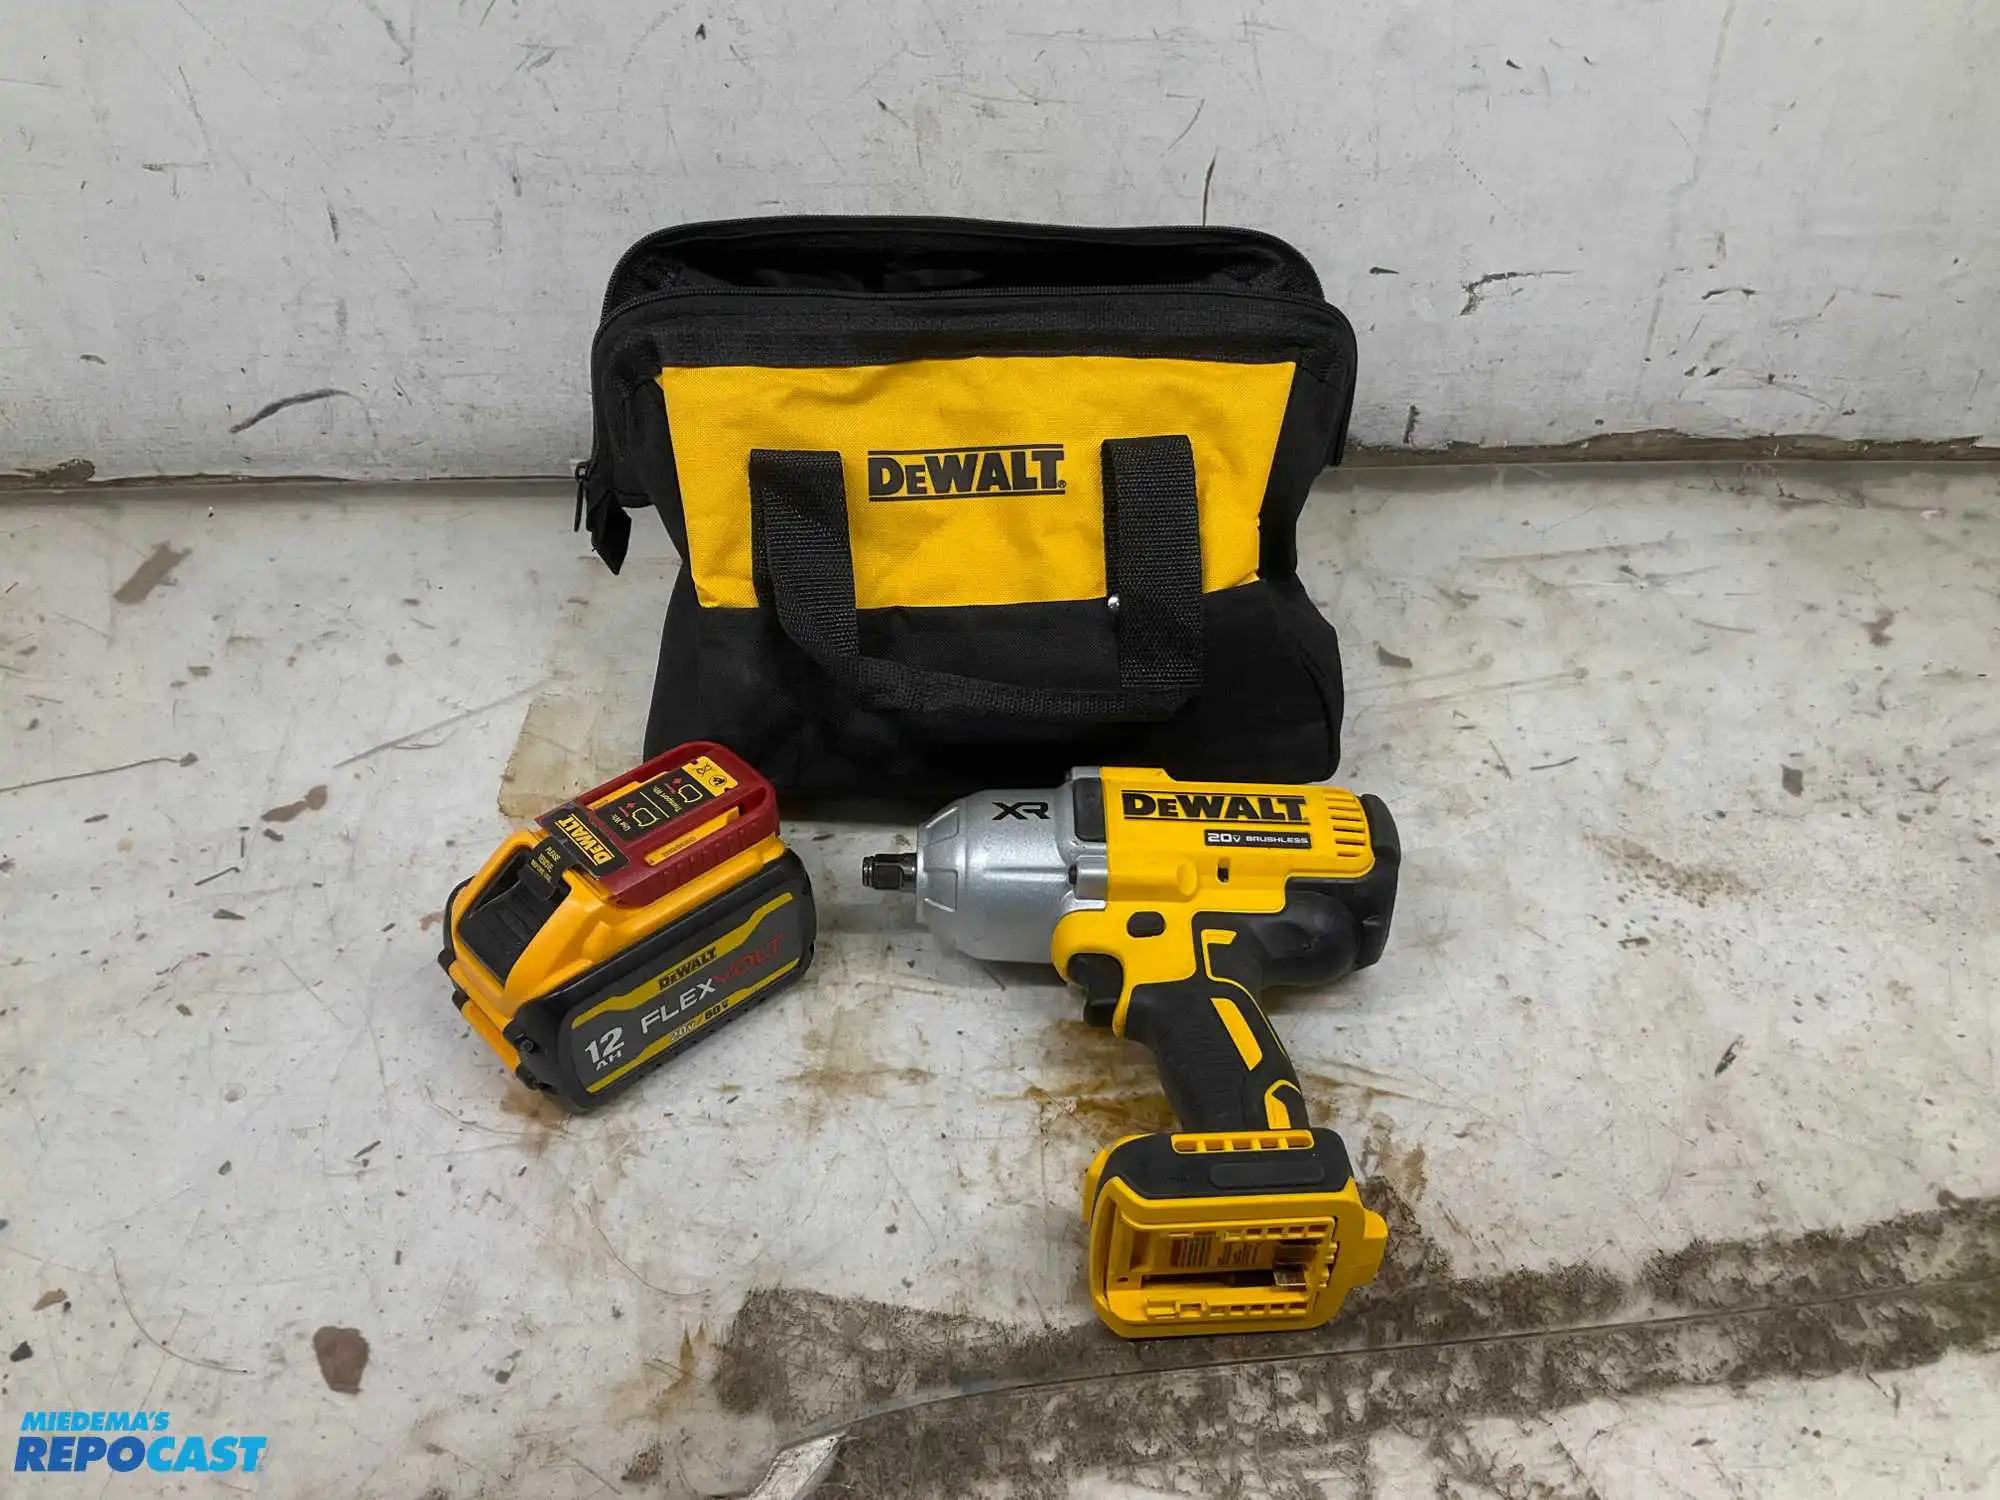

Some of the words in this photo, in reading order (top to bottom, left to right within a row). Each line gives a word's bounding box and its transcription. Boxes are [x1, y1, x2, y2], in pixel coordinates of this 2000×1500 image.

[992, 801, 1050, 820] XR
[1121, 793, 1307, 821] DEWALT
[558, 816, 613, 865] DEWALT
[1207, 832, 1241, 844] 20V
[1246, 835, 1308, 845] BRUSHLESS
[658, 947, 717, 991] DEWALT
[584, 1027, 625, 1064] 12
